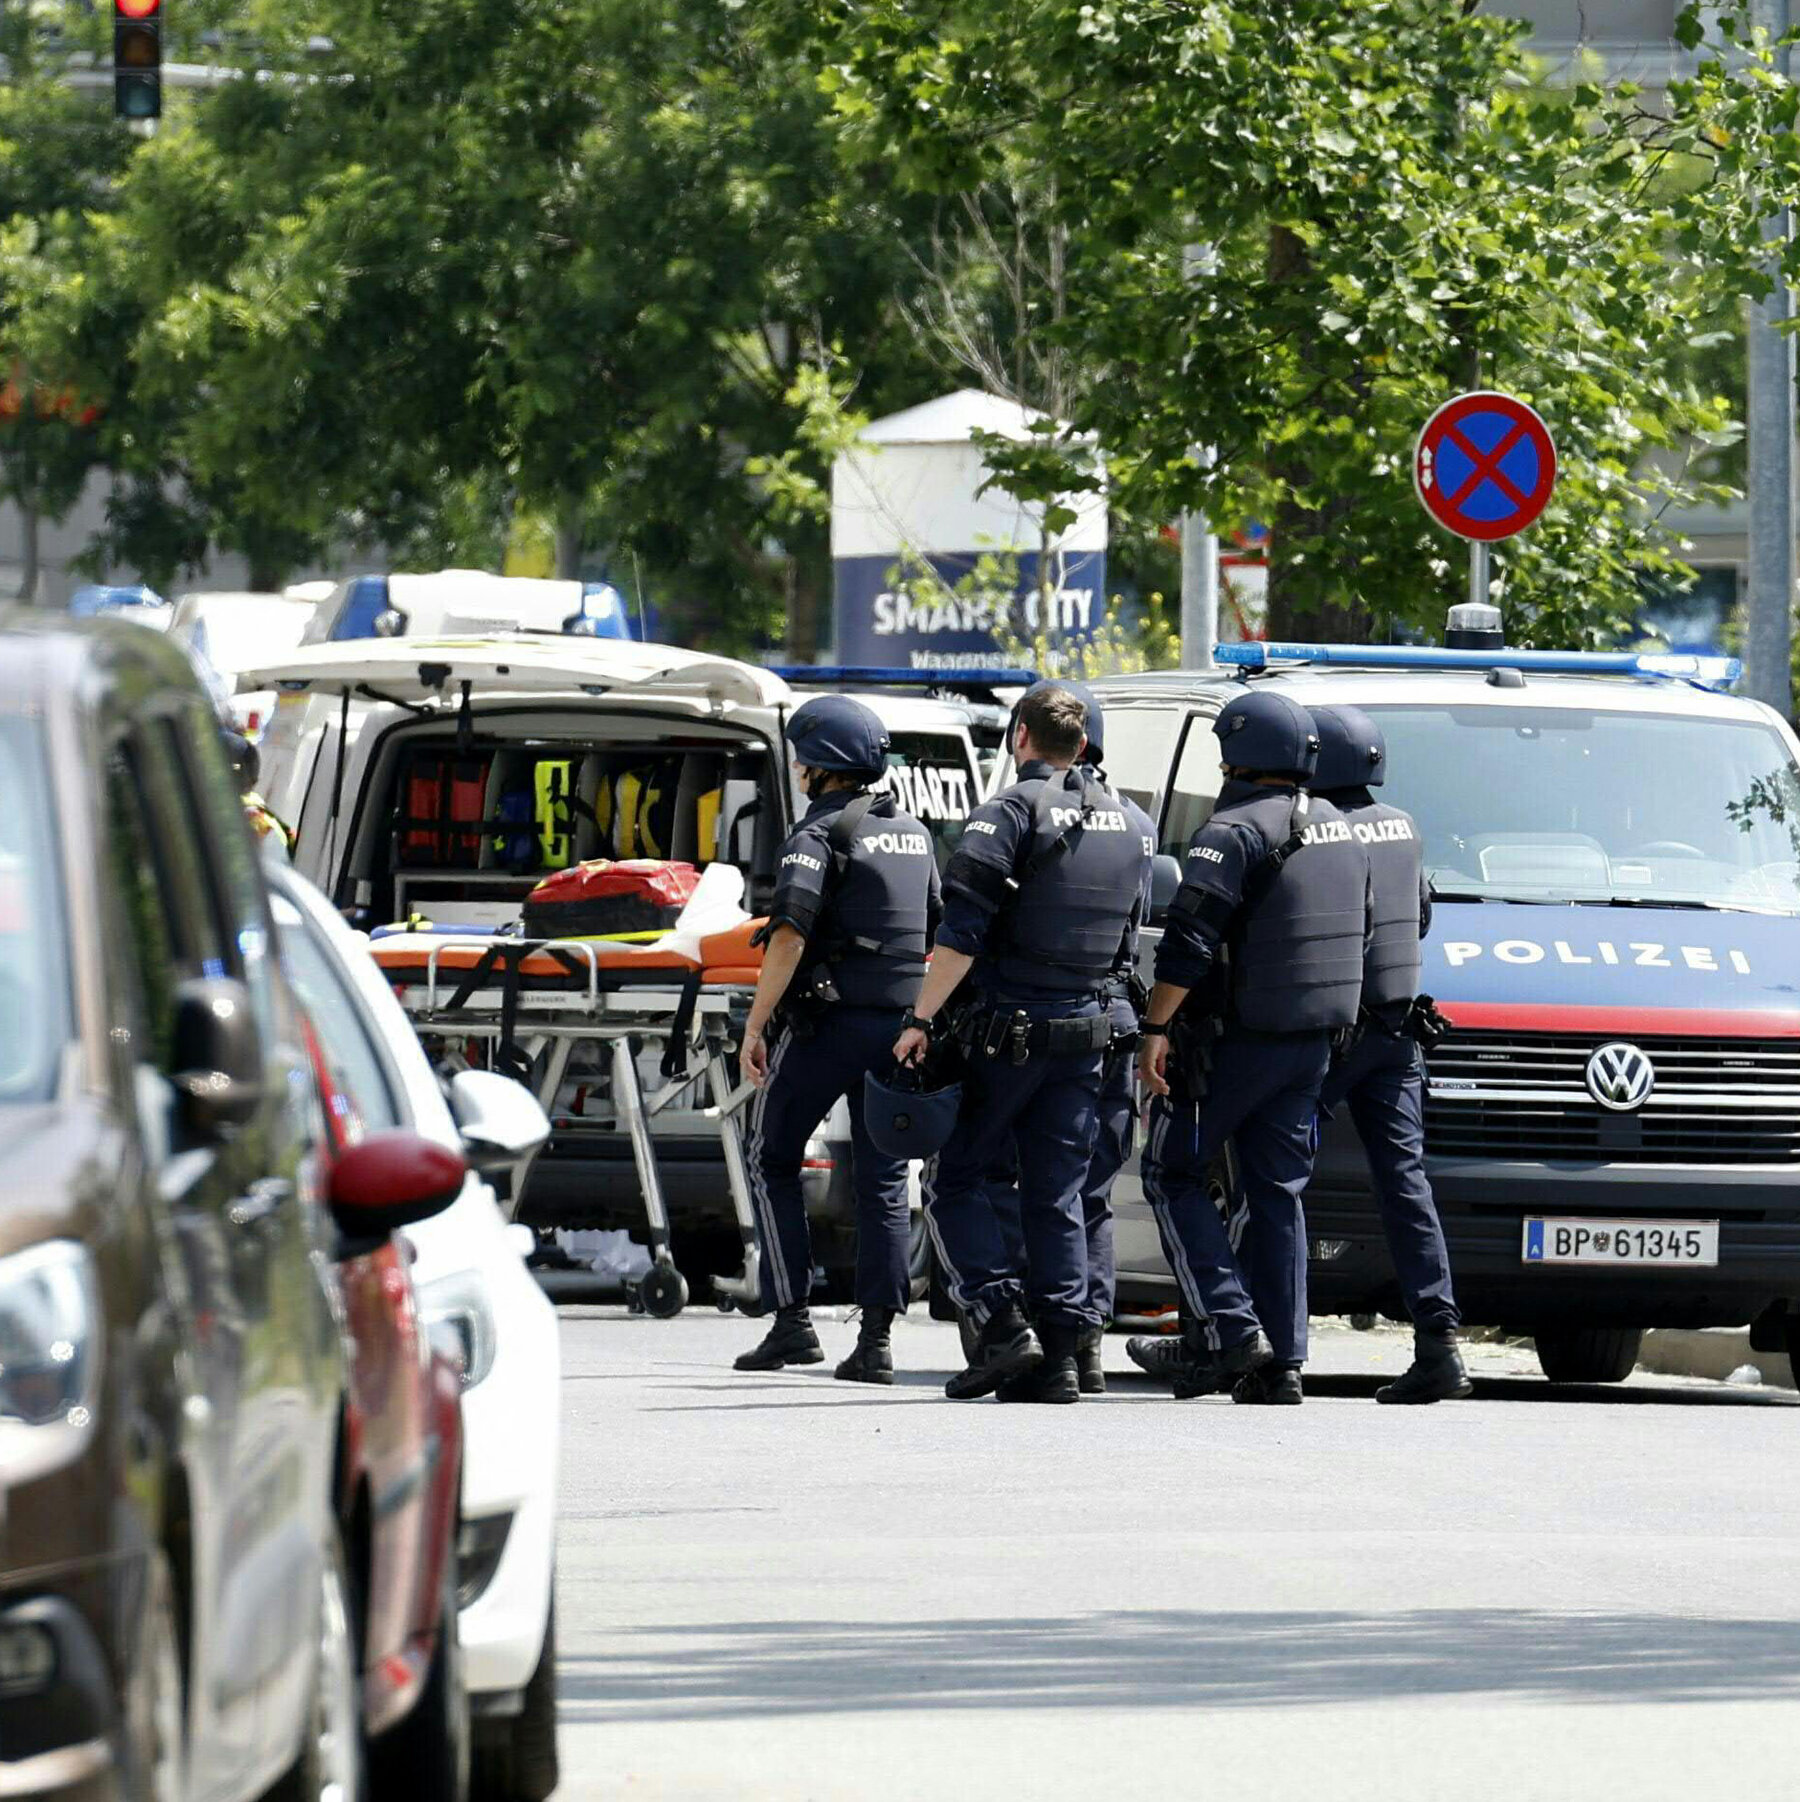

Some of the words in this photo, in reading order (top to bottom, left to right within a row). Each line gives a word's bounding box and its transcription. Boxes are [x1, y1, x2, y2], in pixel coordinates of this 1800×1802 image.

[867, 764, 971, 820] OTARZT
[863, 833, 928, 855] POLIZEI
[1298, 820, 1352, 846] OLIZEI
[1353, 819, 1413, 844] OLIZEI
[781, 852, 821, 871] POLIZEI
[1188, 846, 1224, 864] POLIZEI
[1443, 940, 1751, 974] POLIZEI
[1530, 1244, 1540, 1255] A
[1555, 1227, 1590, 1257] BP
[1614, 1229, 1701, 1259] 61345
